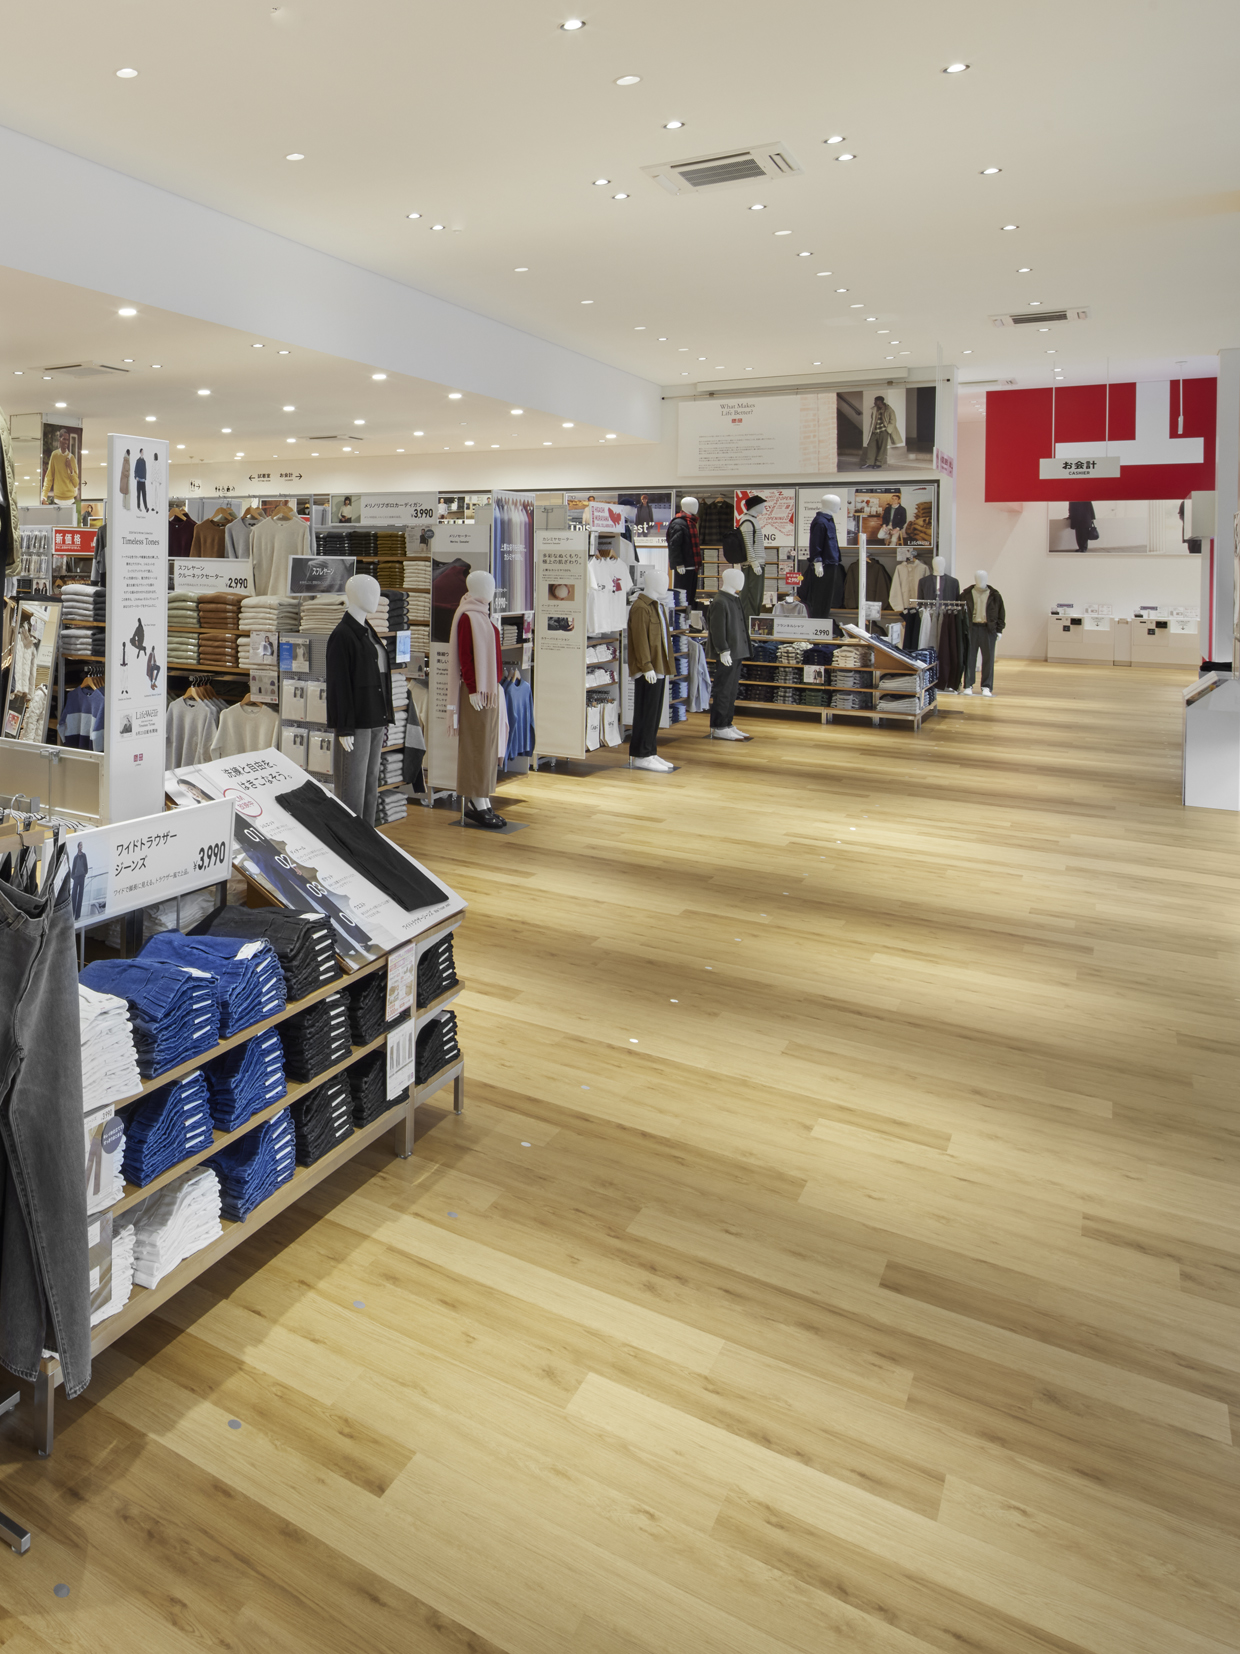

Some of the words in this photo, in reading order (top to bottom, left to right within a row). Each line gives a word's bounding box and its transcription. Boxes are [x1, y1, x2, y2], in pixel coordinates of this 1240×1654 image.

[1062, 460, 1097, 470] お会計
[411, 508, 434, 519] ¥3,990
[55, 533, 81, 544] 新価格
[121, 536, 144, 545] Timeless
[145, 537, 160, 546] Tones
[763, 533, 776, 541] NG
[177, 572, 224, 580] クルーネックセーター
[312, 567, 334, 576] スフレヤーン
[225, 577, 248, 589] ¥2,990
[237, 771, 293, 791] はきこなそう。
[116, 830, 178, 857] ワイドトラウザー
[193, 840, 226, 872] ¥3,990
[274, 853, 297, 869] 02
[114, 855, 148, 877] ジーンズ
[306, 881, 328, 897] 03
